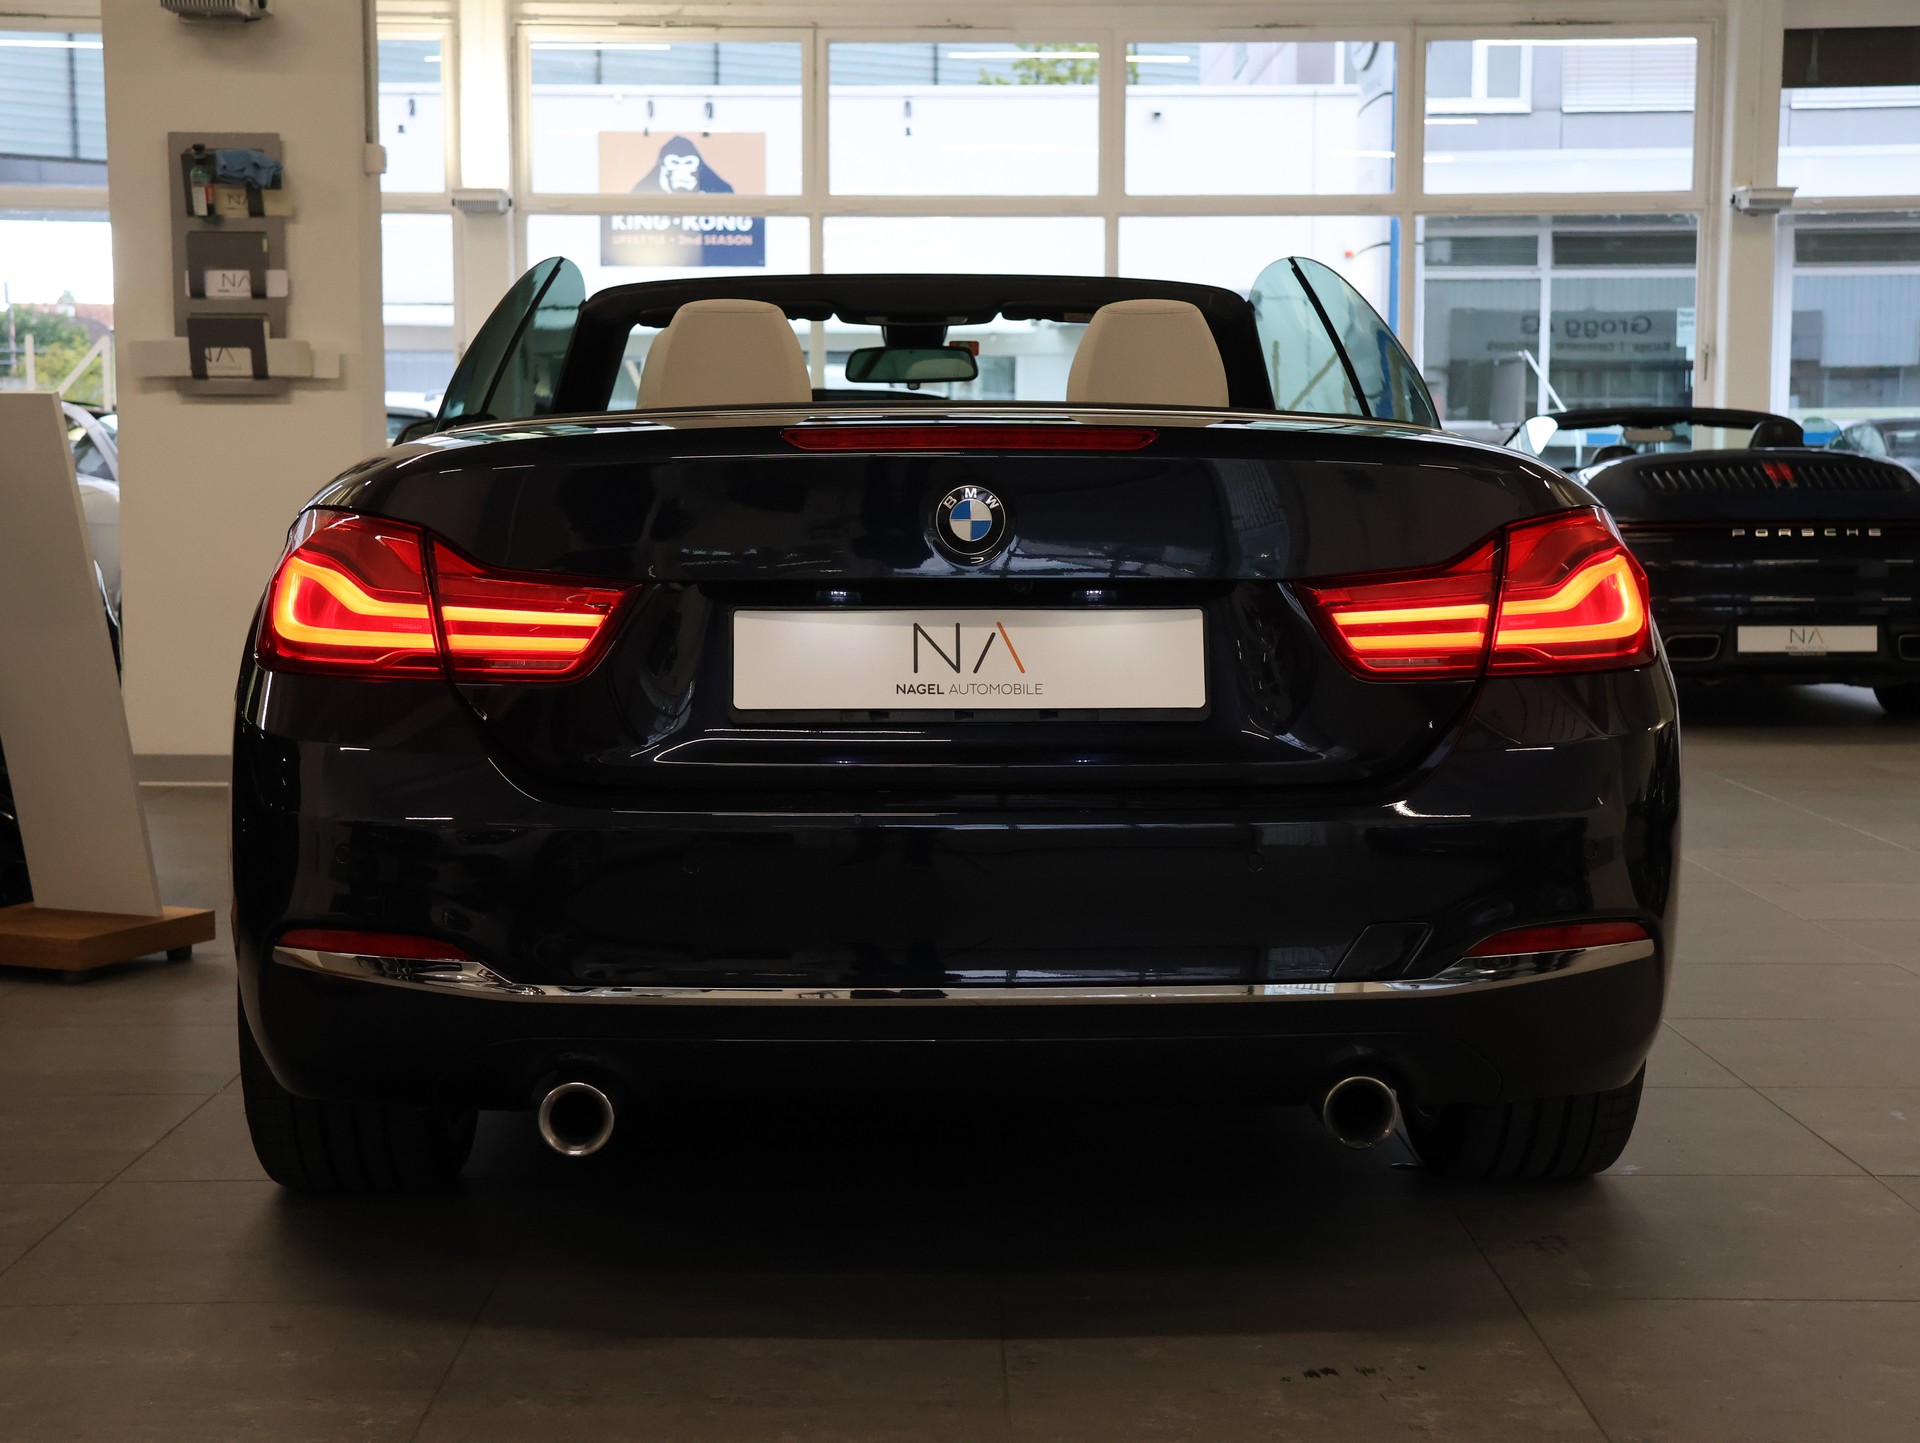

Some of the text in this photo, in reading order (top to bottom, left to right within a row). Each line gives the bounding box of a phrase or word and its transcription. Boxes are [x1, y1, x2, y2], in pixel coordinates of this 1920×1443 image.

[611, 215, 754, 232] KING KONG
[704, 234, 753, 246] SEASON
[943, 487, 999, 510] BMW
[1732, 528, 1882, 537] PORSCHE
[1789, 627, 1825, 644] NA
[913, 621, 1025, 674] NA
[896, 683, 1044, 695] NAGEL AUTOMOBILE
